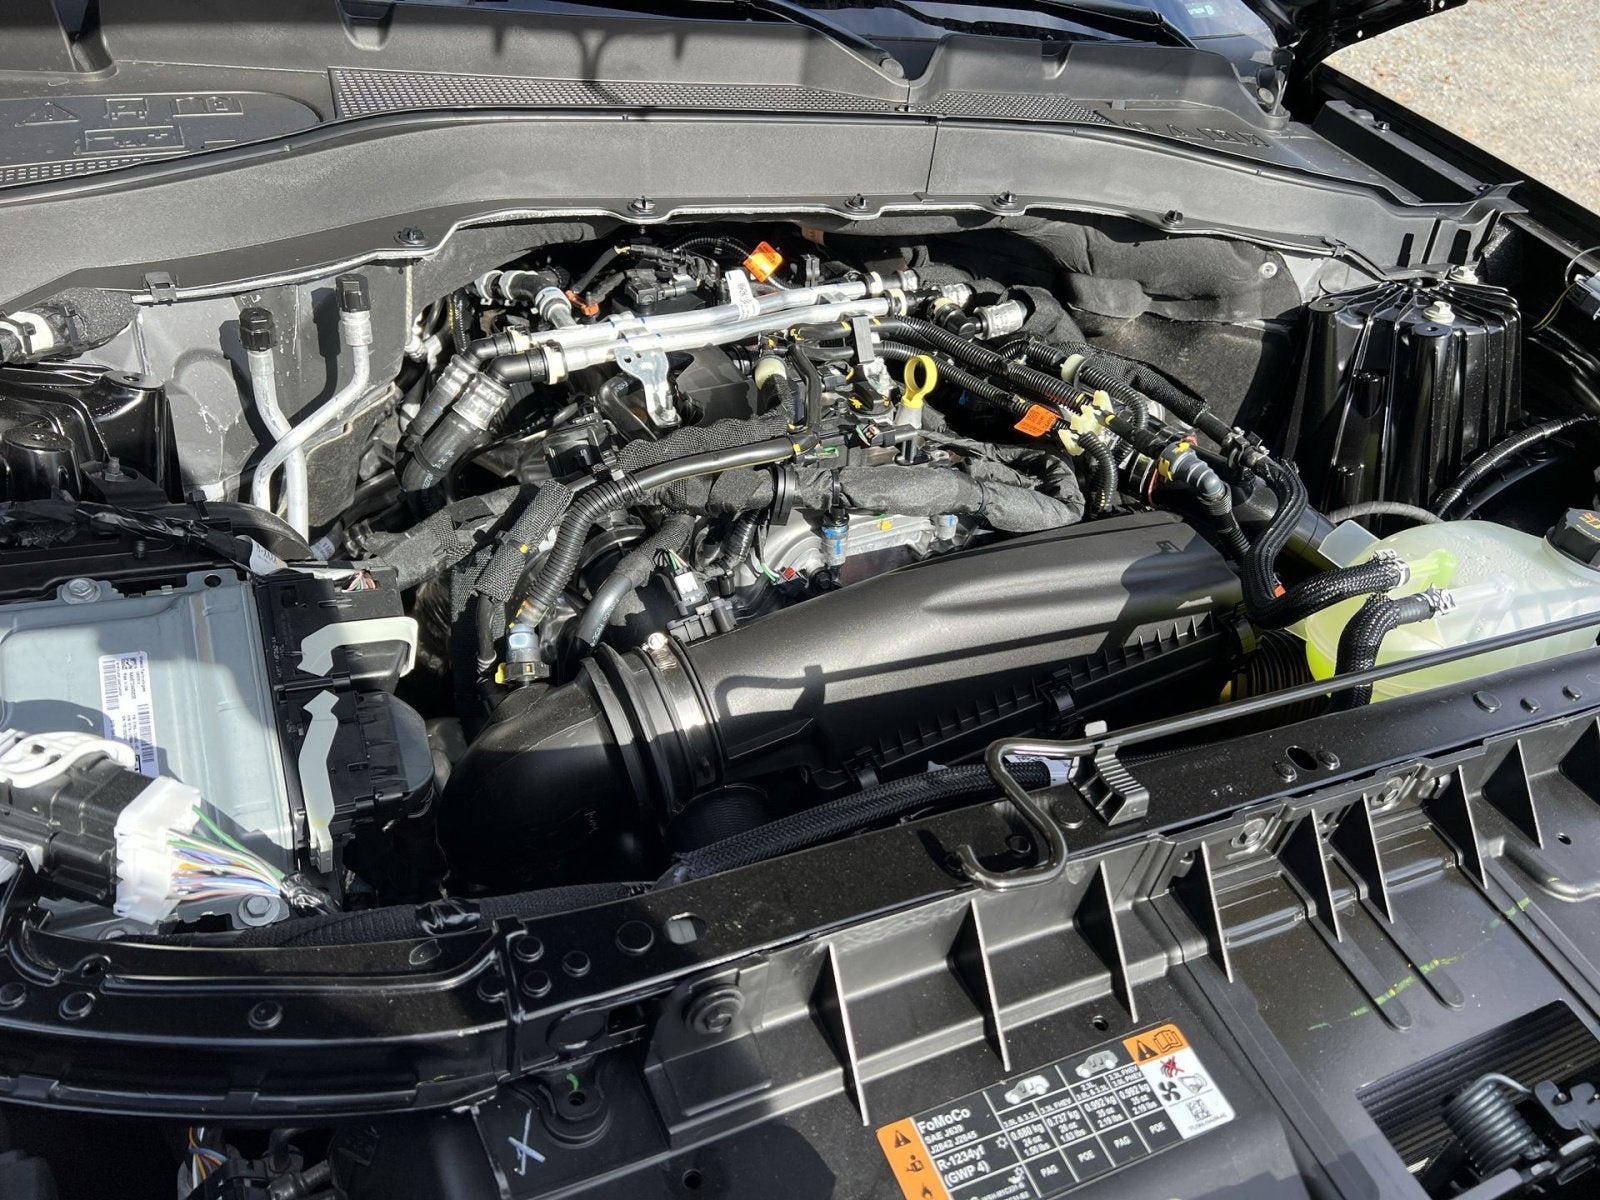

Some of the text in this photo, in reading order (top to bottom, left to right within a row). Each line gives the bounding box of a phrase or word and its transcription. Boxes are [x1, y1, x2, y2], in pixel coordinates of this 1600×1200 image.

[1137, 1082, 1152, 1093] kg
[1084, 1095, 1118, 1112] 0.992 kg
[917, 1108, 971, 1135] FoMoCo
[1046, 1109, 1081, 1127] 0.737 kg
[924, 1123, 964, 1145] SAE J639
[1031, 1123, 1045, 1134] kg
[1148, 1121, 1166, 1135] POE
[930, 1130, 978, 1155] J2842 J2845
[1113, 1135, 1132, 1149] PAG
[936, 1143, 986, 1171] R-1234yf
[1077, 1149, 1096, 1163] POE
[944, 1159, 990, 1188] (GWP 4)
[1040, 1164, 1059, 1178] PAG
